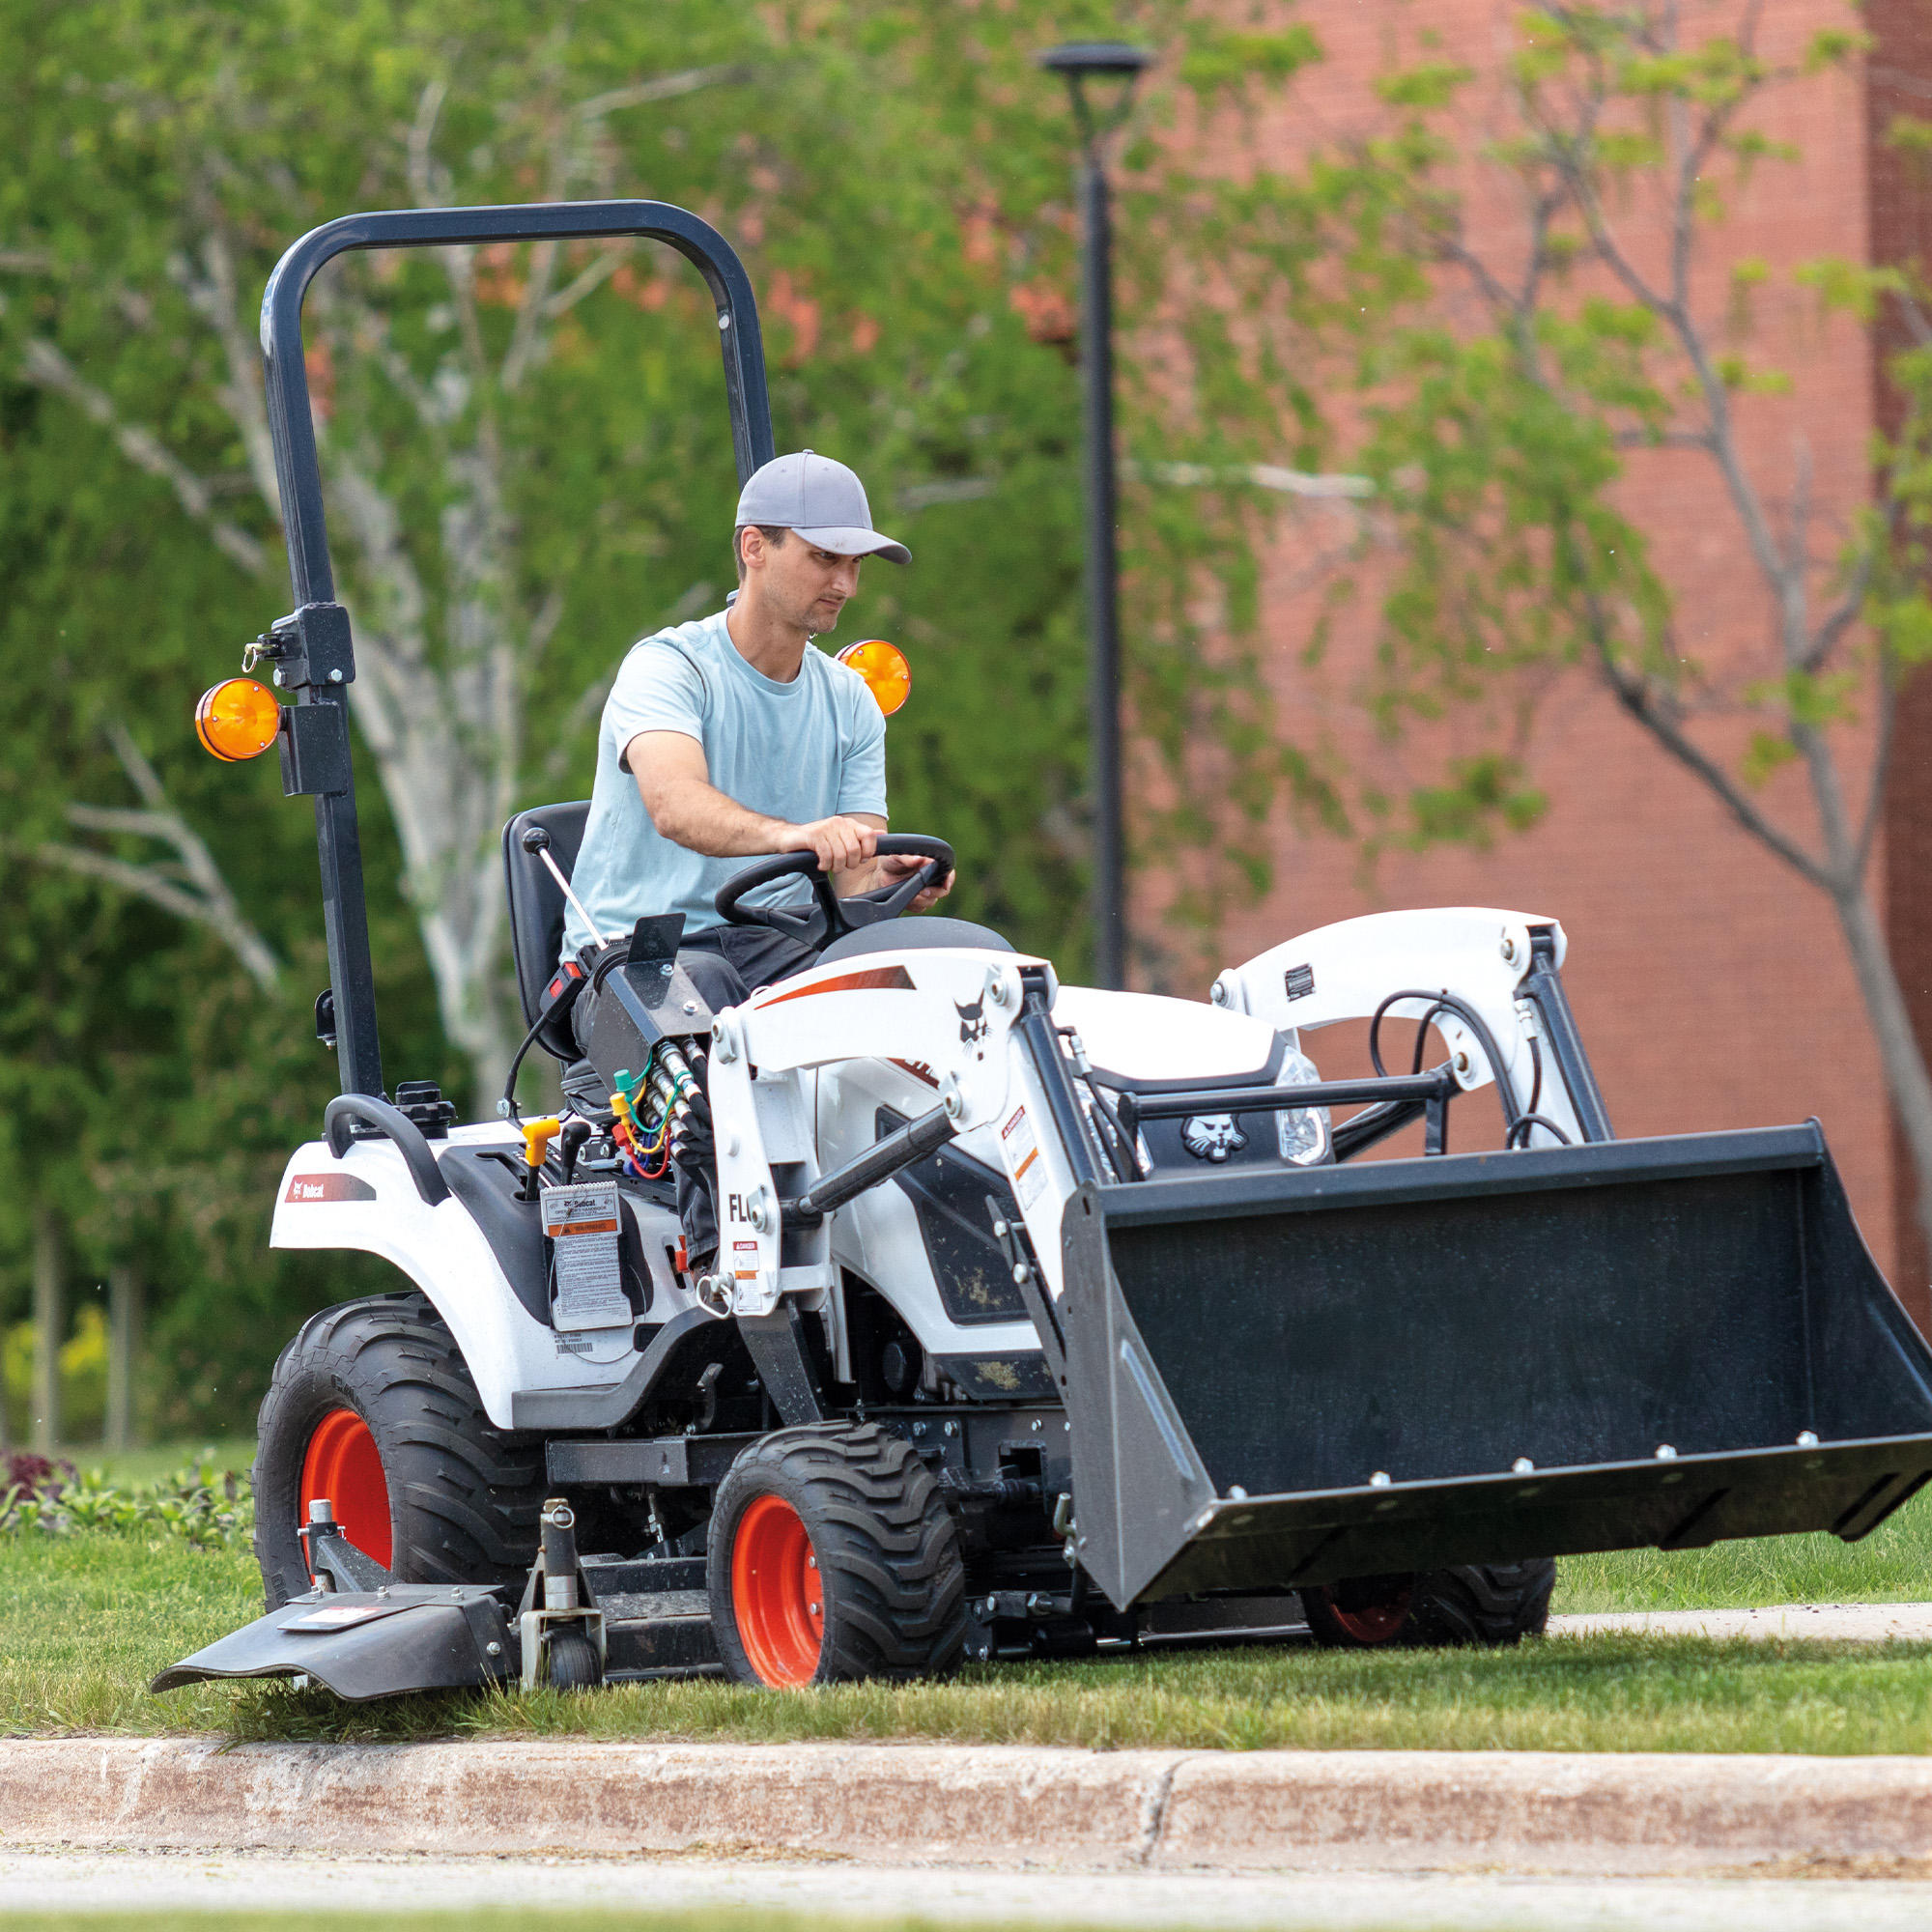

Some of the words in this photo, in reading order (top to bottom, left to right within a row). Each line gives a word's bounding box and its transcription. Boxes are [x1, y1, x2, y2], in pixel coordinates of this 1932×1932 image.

[302, 1183, 324, 1199] Bobcat
[574, 1199, 596, 1208] Bobcat
[728, 1193, 752, 1222] FL
